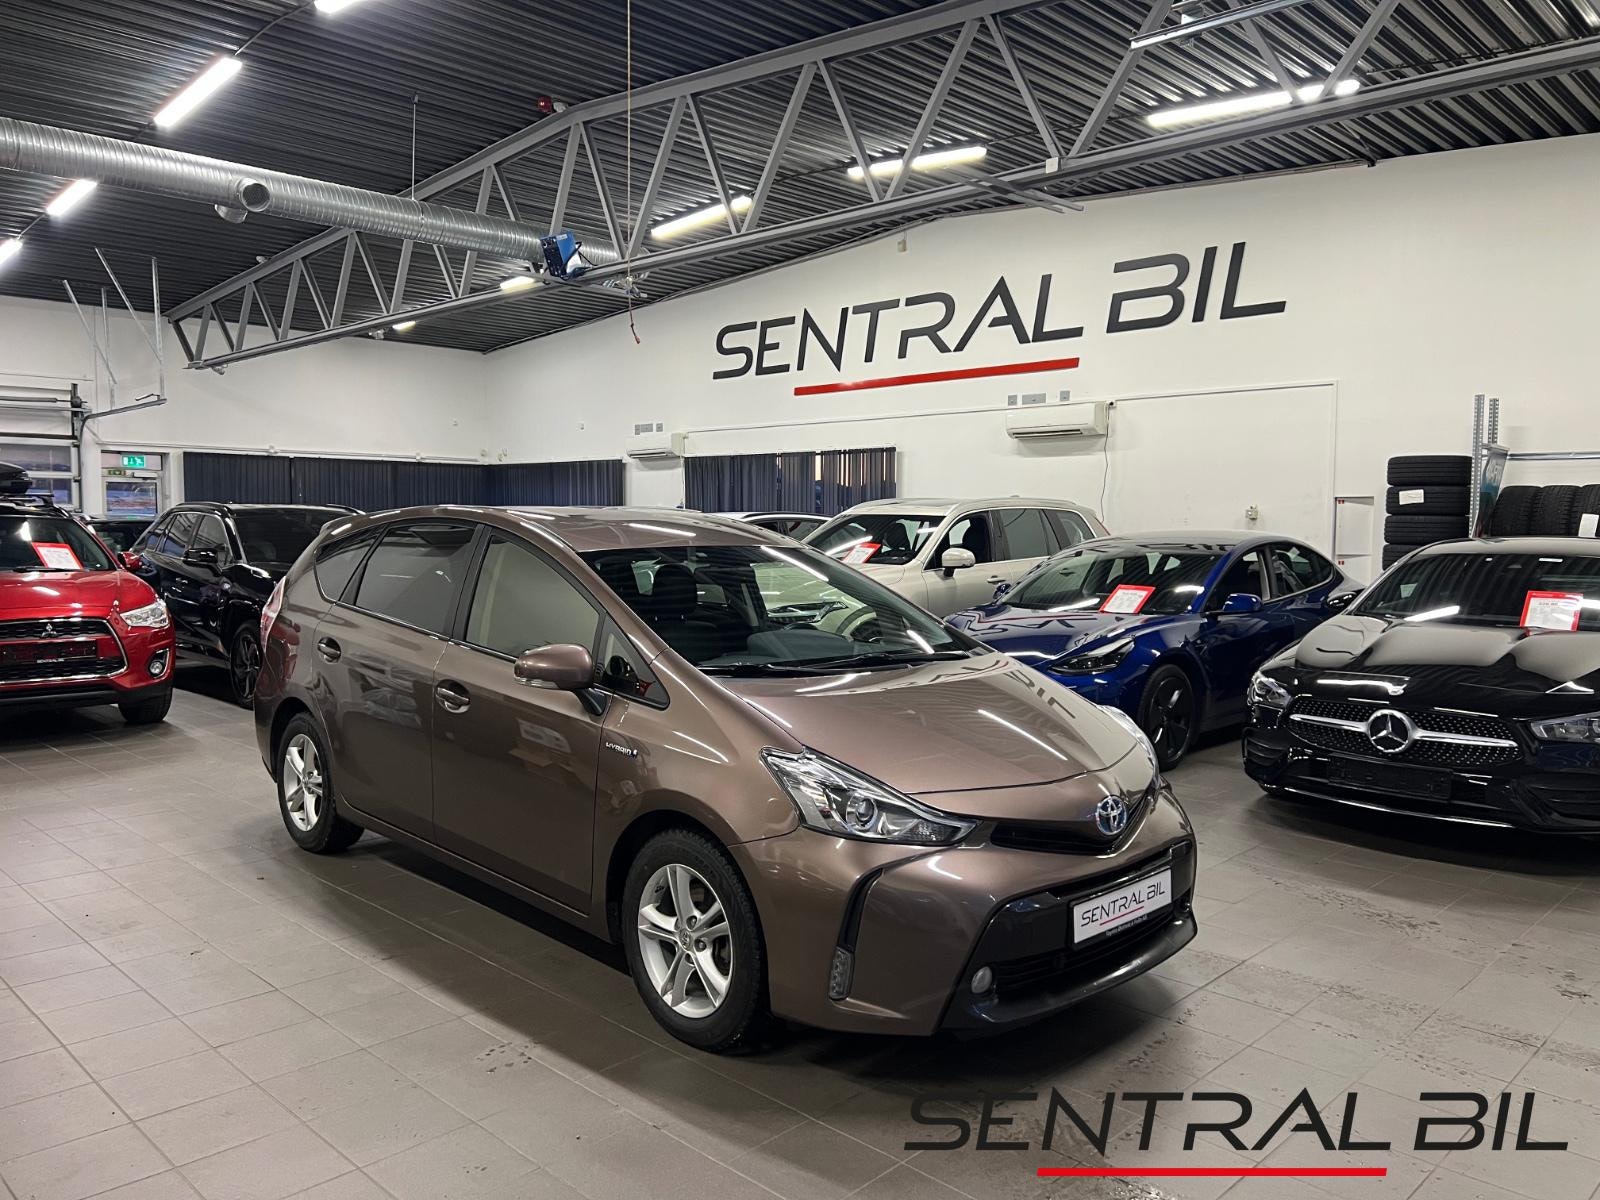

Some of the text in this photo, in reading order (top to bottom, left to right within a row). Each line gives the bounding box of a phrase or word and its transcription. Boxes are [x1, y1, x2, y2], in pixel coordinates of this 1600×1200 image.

[713, 241, 1286, 380] SENTRAL BIL
[1081, 890, 1144, 927] SENTRAL
[1147, 882, 1165, 900] BIL
